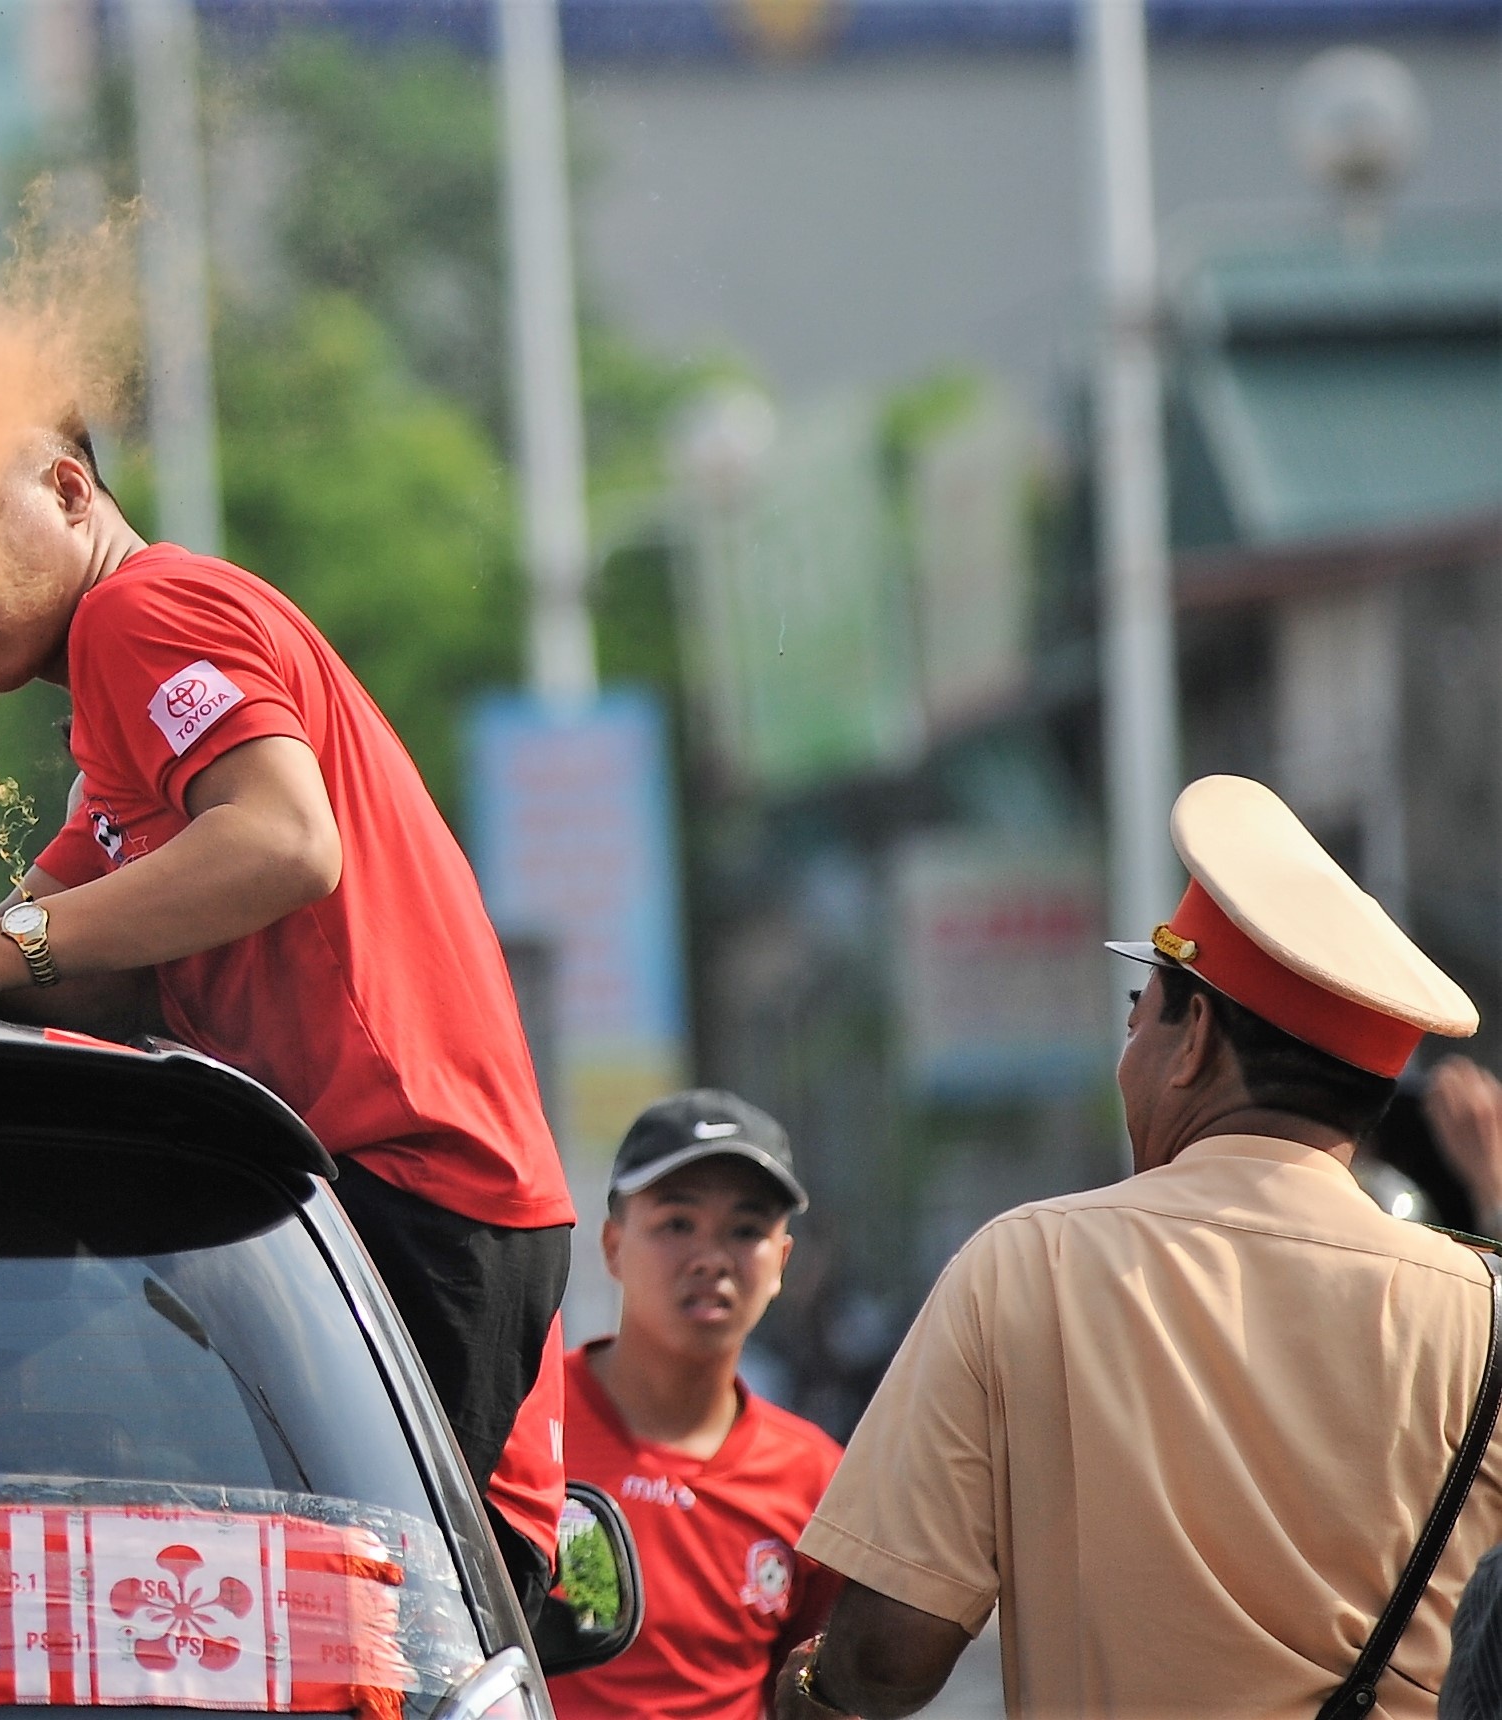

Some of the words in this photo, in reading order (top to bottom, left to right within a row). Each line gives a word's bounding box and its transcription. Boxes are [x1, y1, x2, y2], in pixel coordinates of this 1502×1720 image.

[176, 691, 231, 741] TOYOTA
[278, 1589, 332, 1612] PSC.1
[27, 1631, 83, 1651] PSC.1
[321, 1643, 375, 1667] PSC.1
